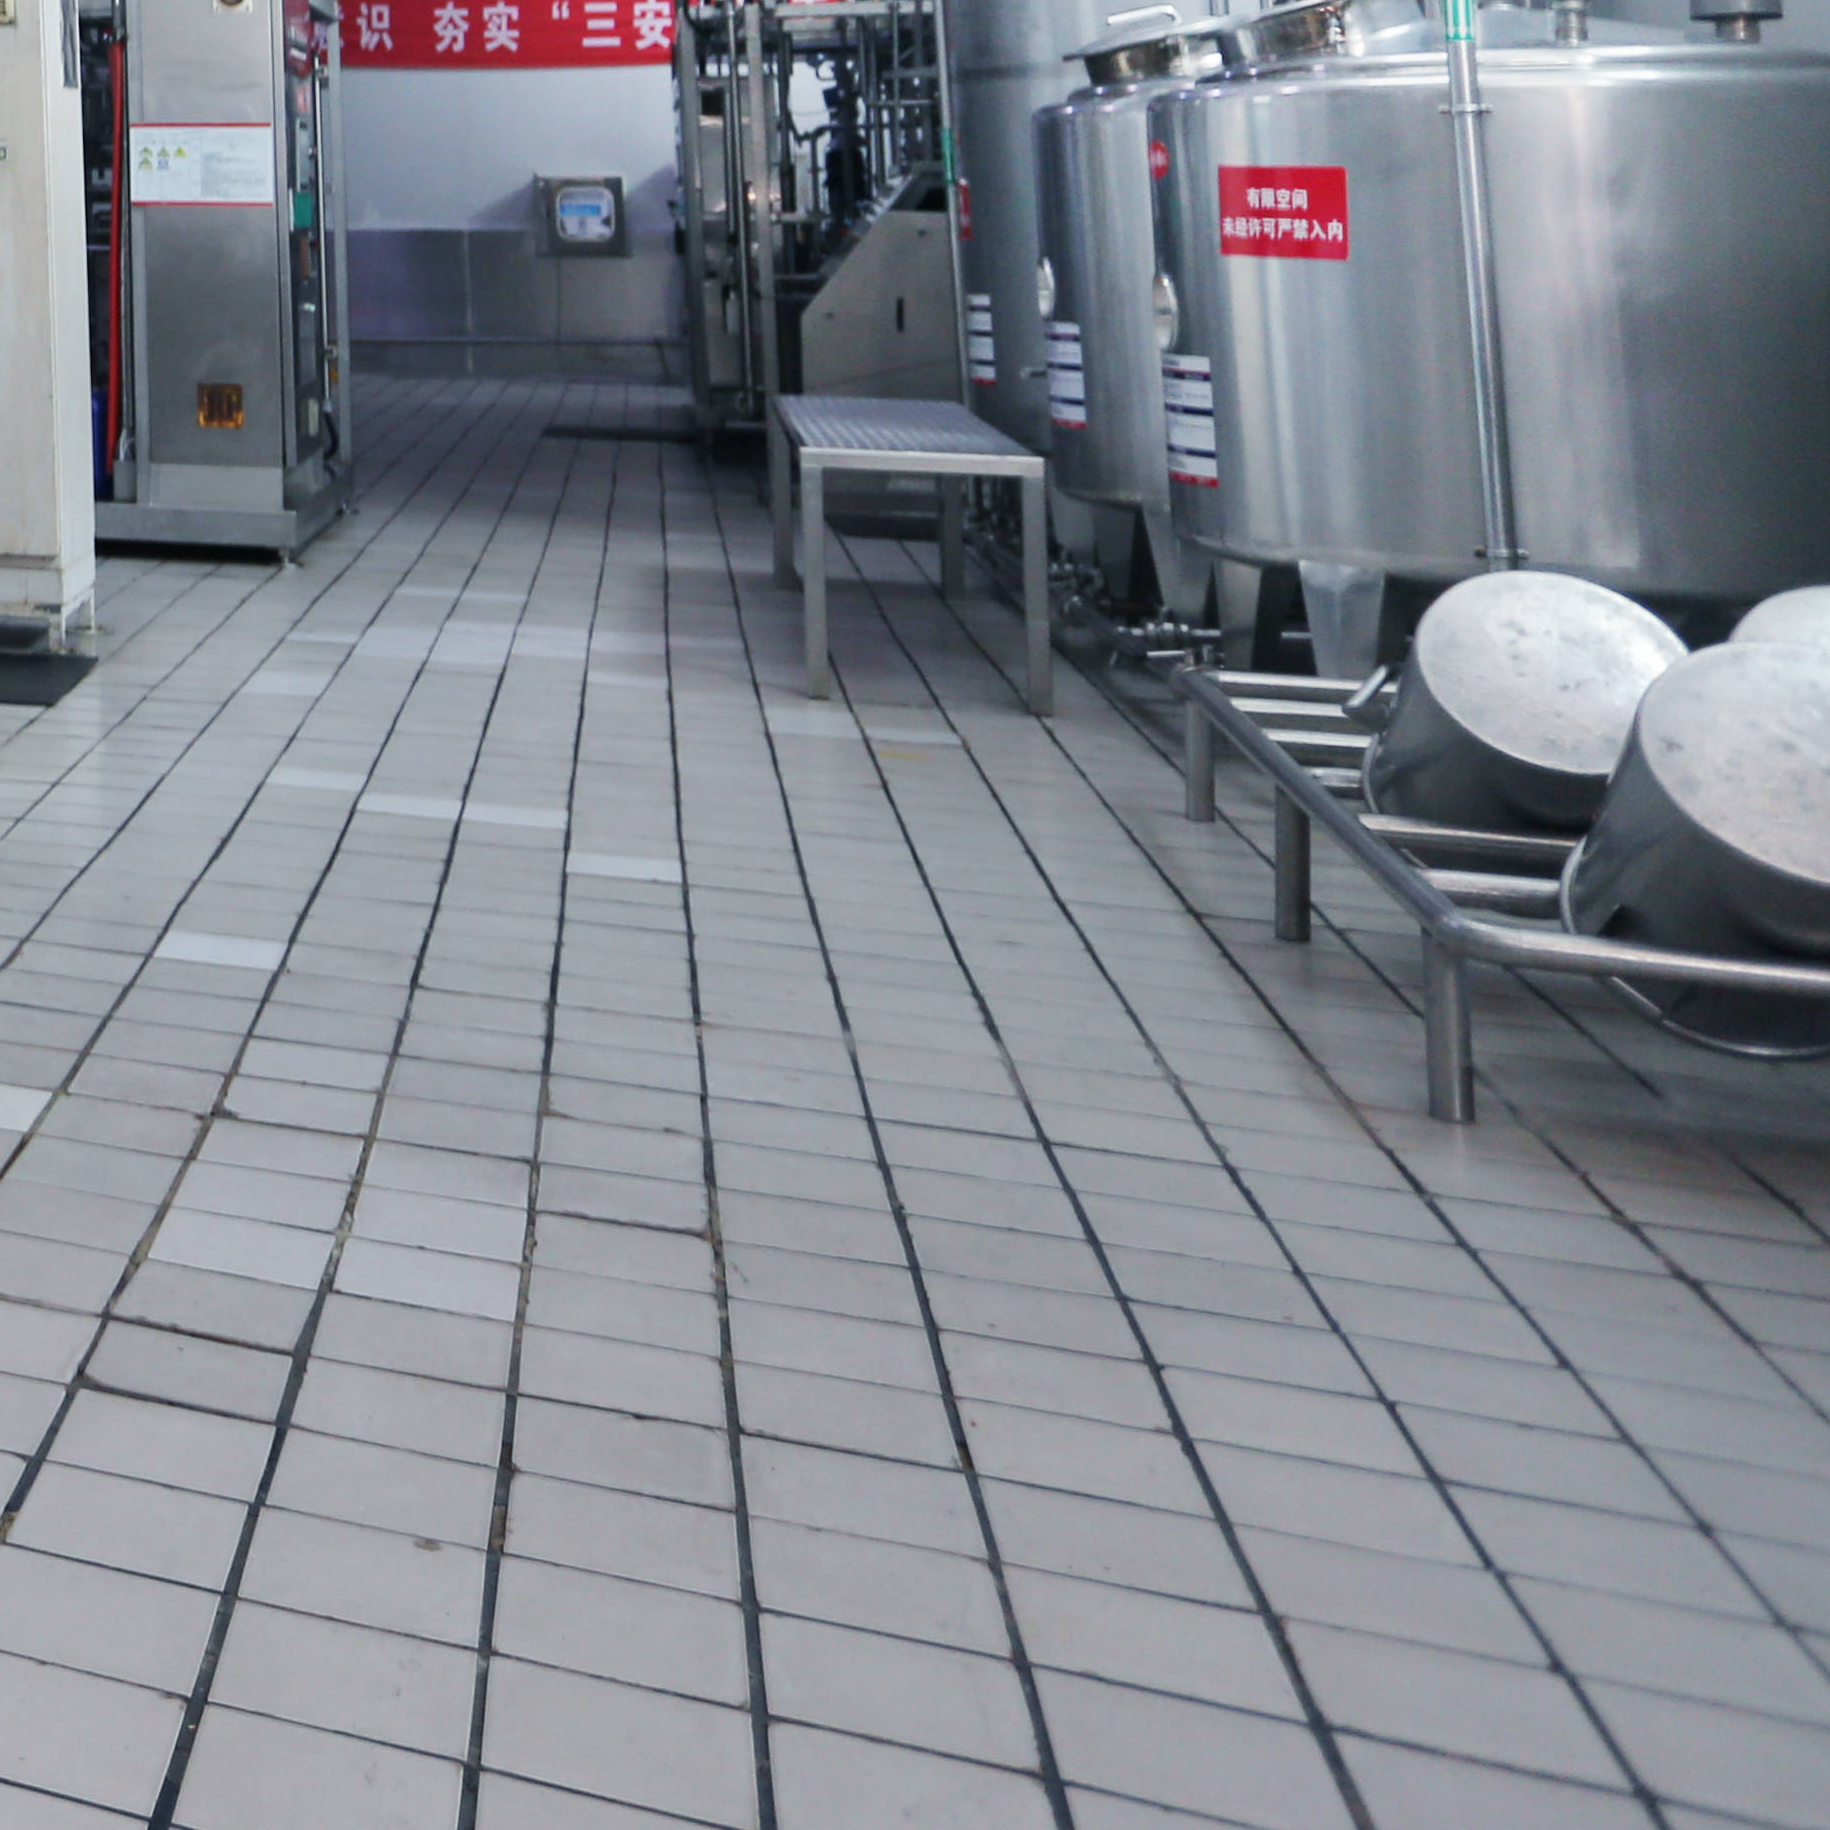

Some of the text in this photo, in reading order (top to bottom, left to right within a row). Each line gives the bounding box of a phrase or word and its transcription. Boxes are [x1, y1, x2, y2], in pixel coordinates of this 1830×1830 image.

[433, 0, 520, 53] 夯实
[1247, 188, 1308, 211] 有限空间
[1223, 217, 1344, 241] 未经许可严禁入内
